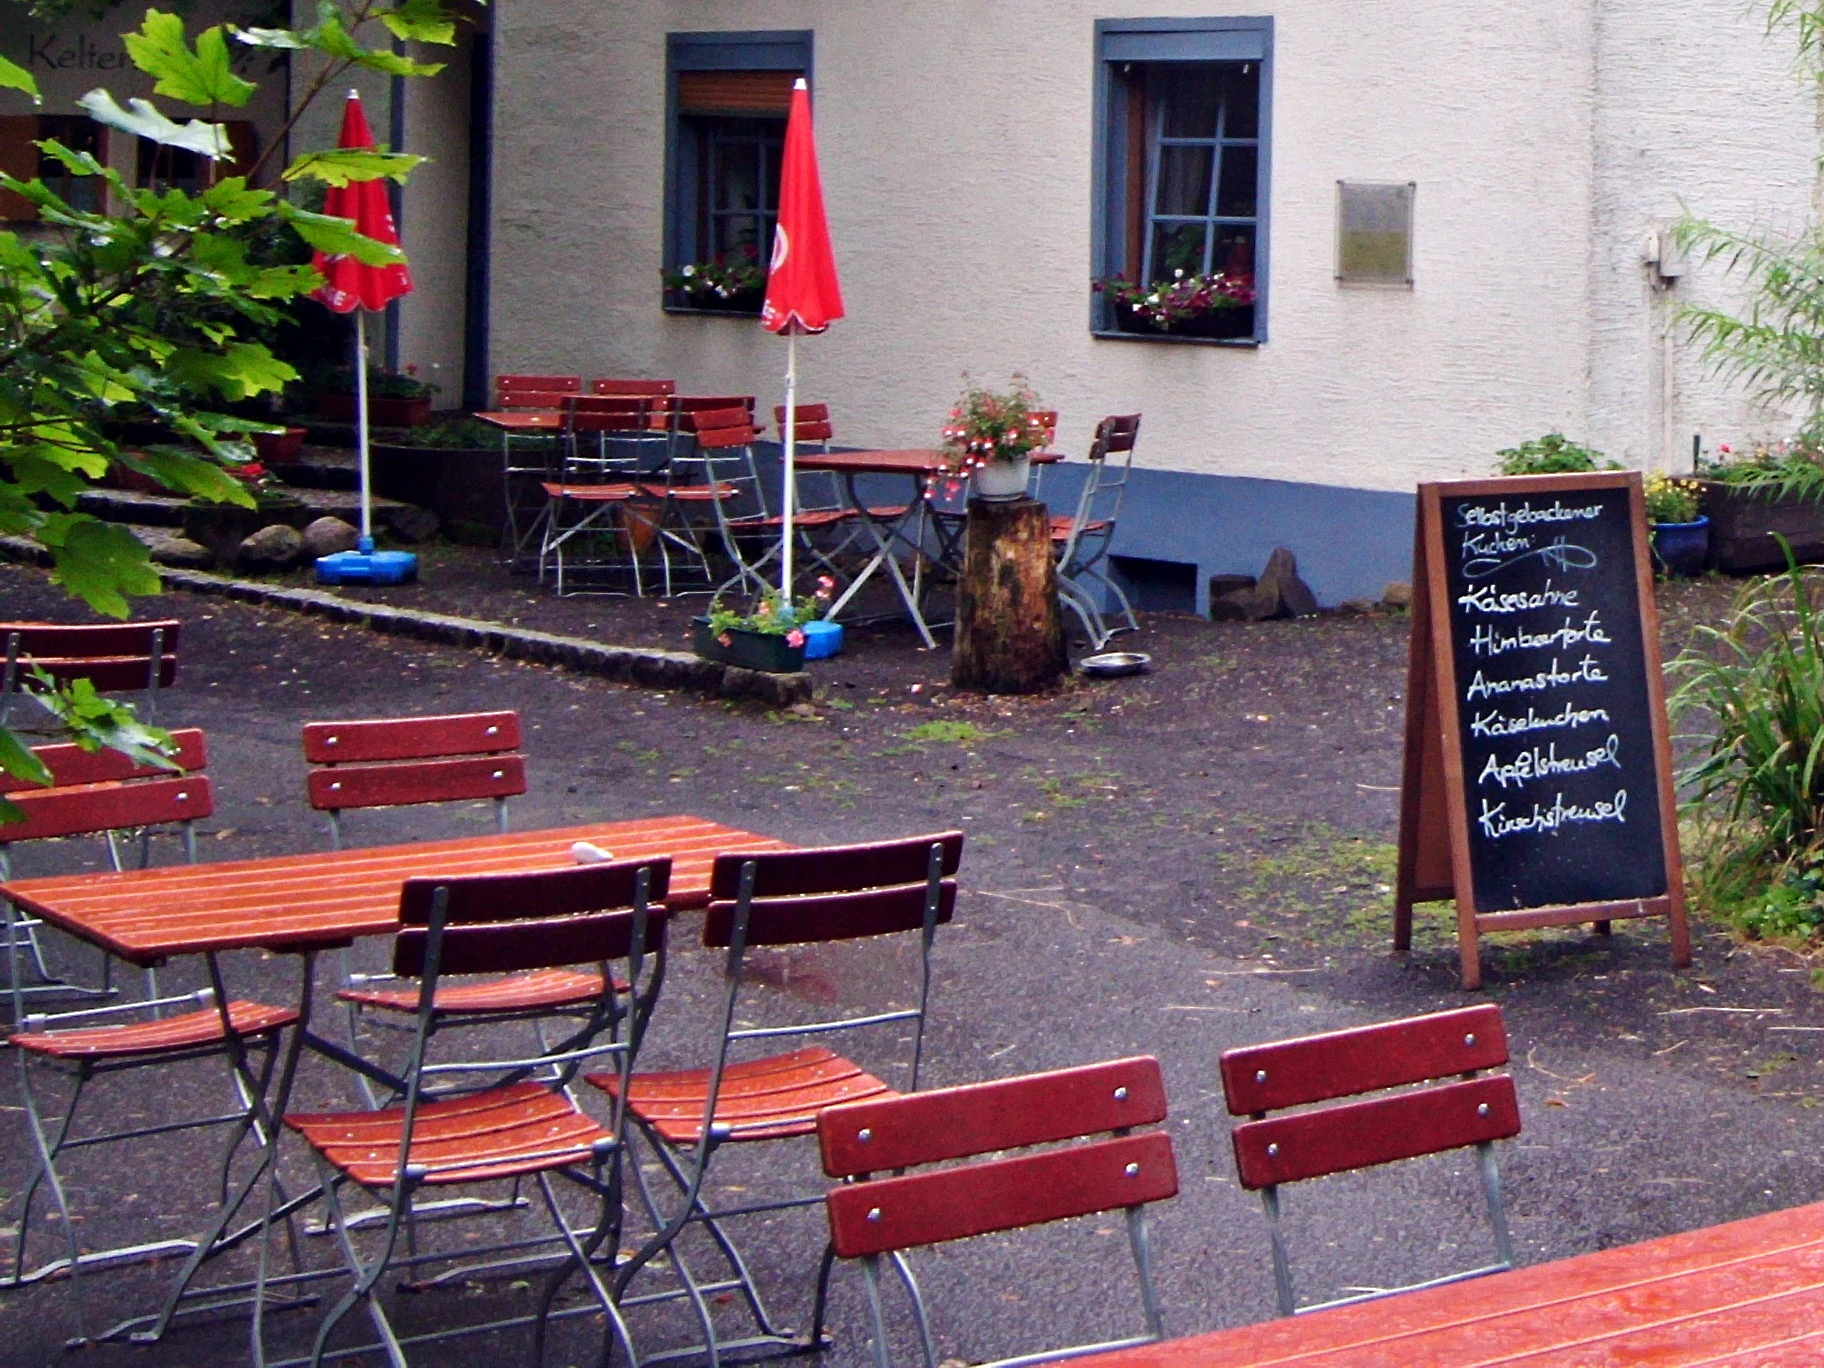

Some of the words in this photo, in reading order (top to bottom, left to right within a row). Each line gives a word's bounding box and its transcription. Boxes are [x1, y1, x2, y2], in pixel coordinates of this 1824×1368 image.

[1458, 579, 1579, 613] Käsesahne
[1467, 654, 1608, 701] Ananastorte
[1471, 702, 1610, 737] Käsekuchen
[1478, 734, 1621, 788] Apfelstreusel
[1478, 789, 1627, 837] Kirschstreusel
